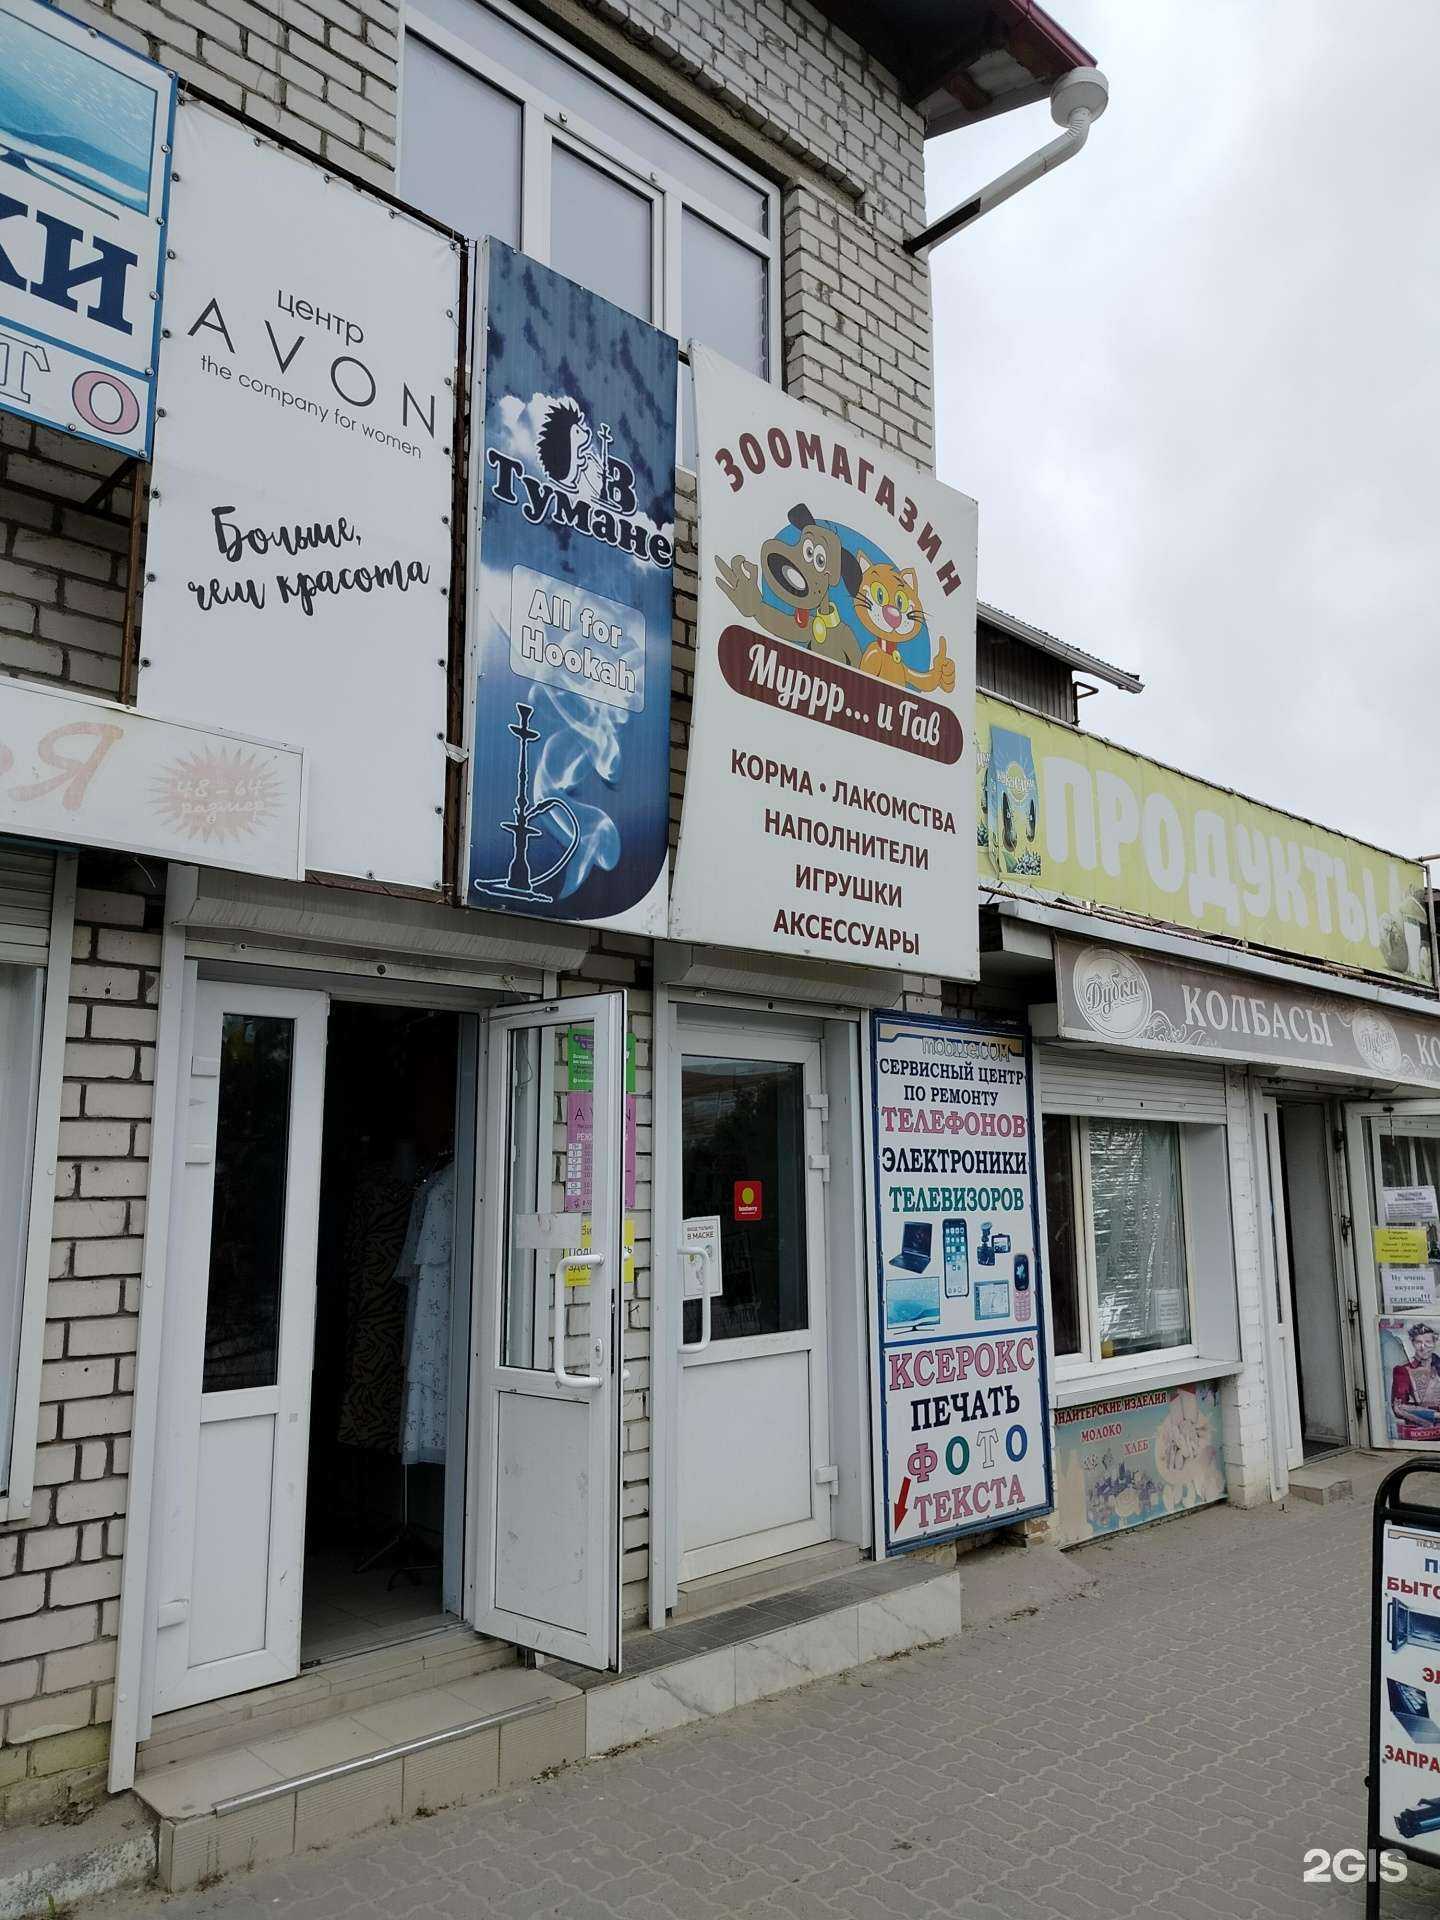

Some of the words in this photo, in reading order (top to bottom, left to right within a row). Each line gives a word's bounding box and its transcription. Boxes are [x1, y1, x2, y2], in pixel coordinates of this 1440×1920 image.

[0, 193, 139, 336] И
[276, 288, 365, 347] центр
[186, 296, 436, 440] AVON
[200, 354, 232, 381] the
[237, 373, 329, 423] company
[334, 408, 357, 432] for
[361, 422, 422, 459] women
[486, 447, 676, 570] Тумане
[714, 427, 962, 598] ЗООМАГАЗИН
[186, 576, 266, 611] чем
[275, 559, 431, 617] красота
[528, 588, 571, 631] All
[579, 606, 623, 649] for
[520, 623, 637, 693] Hookah
[747, 644, 871, 726] Муррр...
[875, 702, 895, 733] и
[898, 699, 942, 747] Гав
[730, 748, 814, 797] КОРМА
[831, 778, 957, 835] ЛАКОМСТВА
[763, 807, 930, 871] НАПОЛНИТЕЛИ
[1041, 755, 1380, 948] ПРОДУКТЫ
[794, 863, 903, 909] ИГРУШКИ
[772, 908, 921, 956] АКСЕССУАРЫ
[1085, 969, 1142, 1016] Дубки
[1180, 983, 1335, 1048] КОЛБАСЫ
[879, 1058, 974, 1081] СЕРВИСНЫЙ
[978, 1067, 1024, 1085] ЦЕНТР
[904, 1085, 926, 1101] ПО
[930, 1087, 999, 1107] РЕМОНТУ
[881, 1106, 1027, 1139] ТЕЛЕФОНОВ
[882, 1147, 1028, 1175] ЭЛЕКТРОНИКИ
[888, 1186, 1025, 1213] ТЕЛЕВИЗОРОВ
[889, 1337, 1036, 1391] КСЕРОКС
[911, 1385, 1020, 1431] ПЕЧАТЬ
[1124, 1392, 1168, 1412] ИЗДЕЛИЯ
[907, 1424, 1028, 1483] ФОТО
[1081, 1423, 1122, 1444] МОЛОКО
[913, 1474, 1026, 1529] ТЕКСТА
